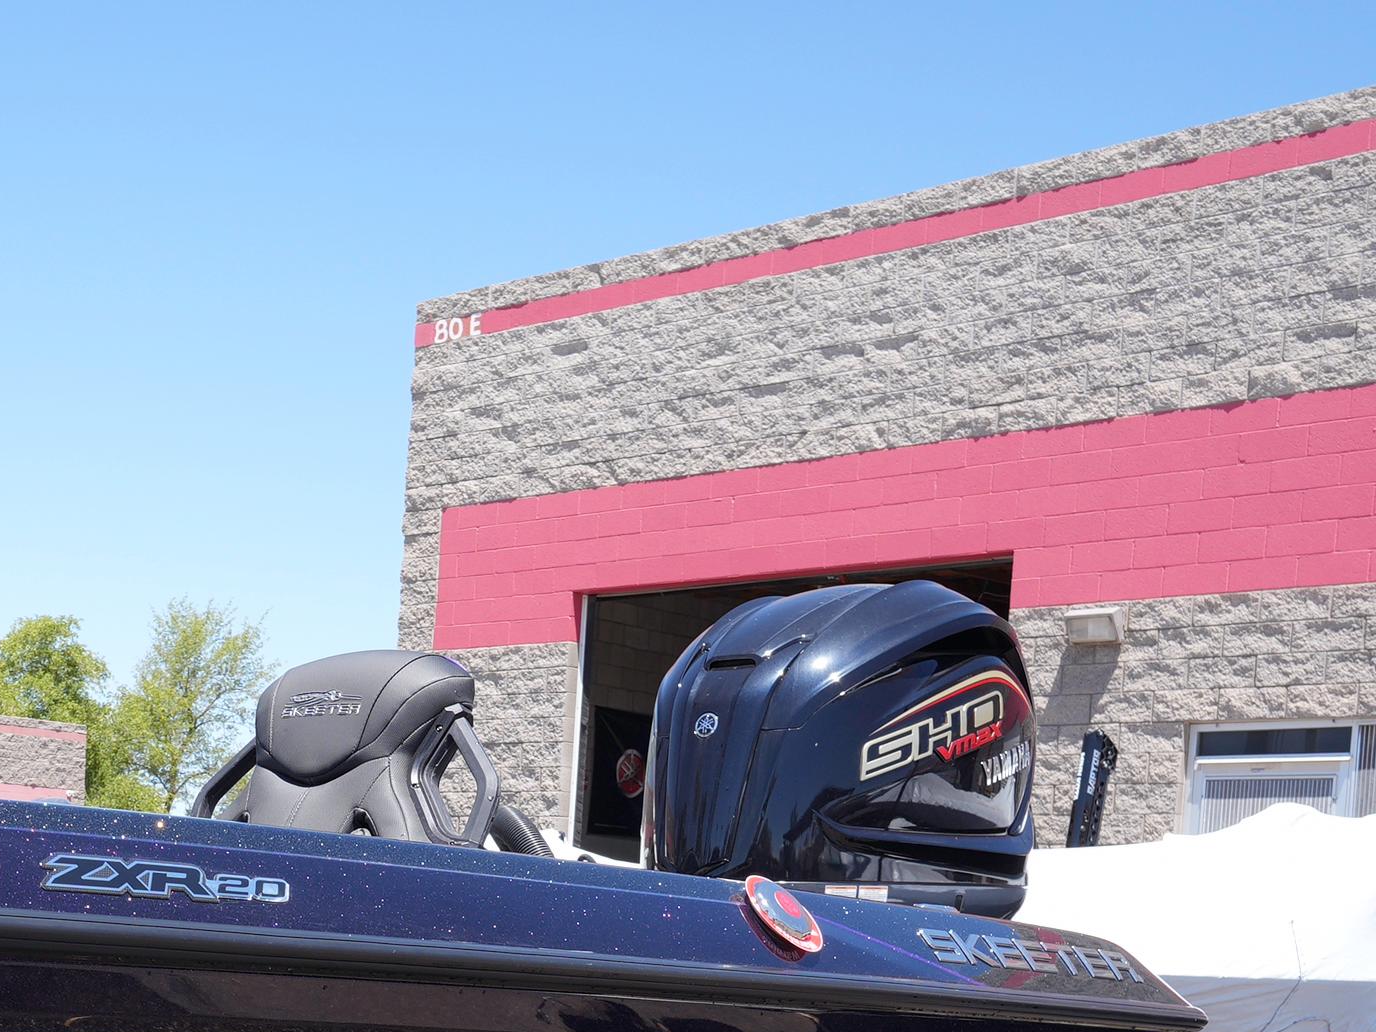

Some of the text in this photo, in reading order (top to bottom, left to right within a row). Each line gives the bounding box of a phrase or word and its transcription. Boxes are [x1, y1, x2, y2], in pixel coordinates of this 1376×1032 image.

[469, 312, 482, 336] E
[281, 702, 361, 719] SKEETER
[859, 690, 1004, 782] SHO
[1086, 749, 1102, 796] RAPTOR
[40, 854, 290, 903] ZXR 20
[916, 927, 1144, 984] SKEETER
